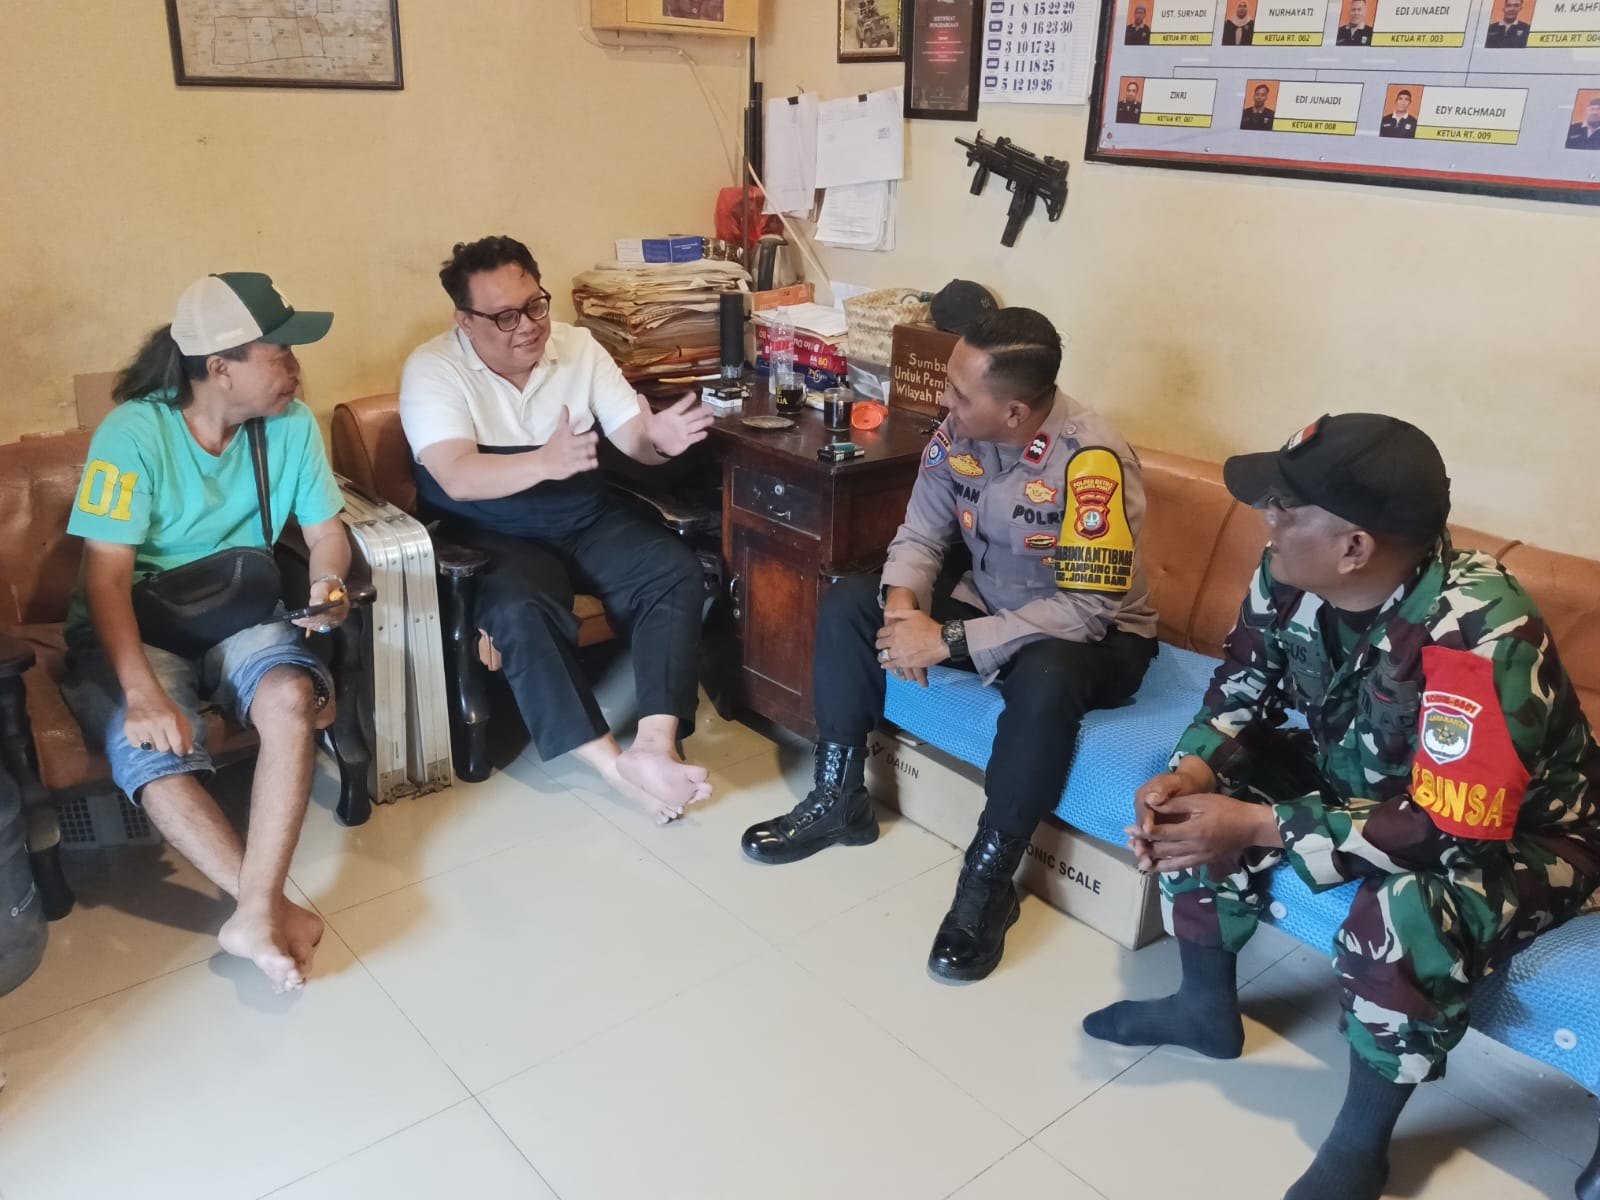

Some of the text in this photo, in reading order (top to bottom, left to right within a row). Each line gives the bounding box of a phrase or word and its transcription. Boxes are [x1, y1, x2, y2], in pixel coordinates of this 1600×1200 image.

[1009, 1, 1075, 16] 1 8 15 22 29
[1178, 9, 1207, 17] SURYADI
[1269, 8, 1314, 16] NURHAYATI
[1395, 6, 1450, 16] EDI JUNAEDI
[1007, 21, 1073, 35] 2 9 16 23 30
[1264, 34, 1285, 42] KETUA
[1390, 34, 1415, 42] KETUA
[1430, 34, 1444, 42] 003
[1539, 34, 1568, 42] KETUA
[1005, 40, 1056, 53] 3 10 17 24
[1004, 60, 1054, 72] 4 11 18 25
[1001, 78, 1052, 91] 5 12 19 26
[1309, 96, 1341, 104] JUNAIDI
[1435, 105, 1506, 117] EDY RACHMADI
[1291, 121, 1313, 129] KETUA
[1436, 130, 1461, 138] KETUA
[1477, 132, 1491, 140] 009
[909, 352, 947, 372] Sumba
[895, 365, 951, 390] Untuk Pemb
[896, 381, 933, 402] Wilayah
[78, 459, 139, 521] 01
[886, 753, 919, 779] DAIJIN
[1058, 861, 1102, 895] SCALE
